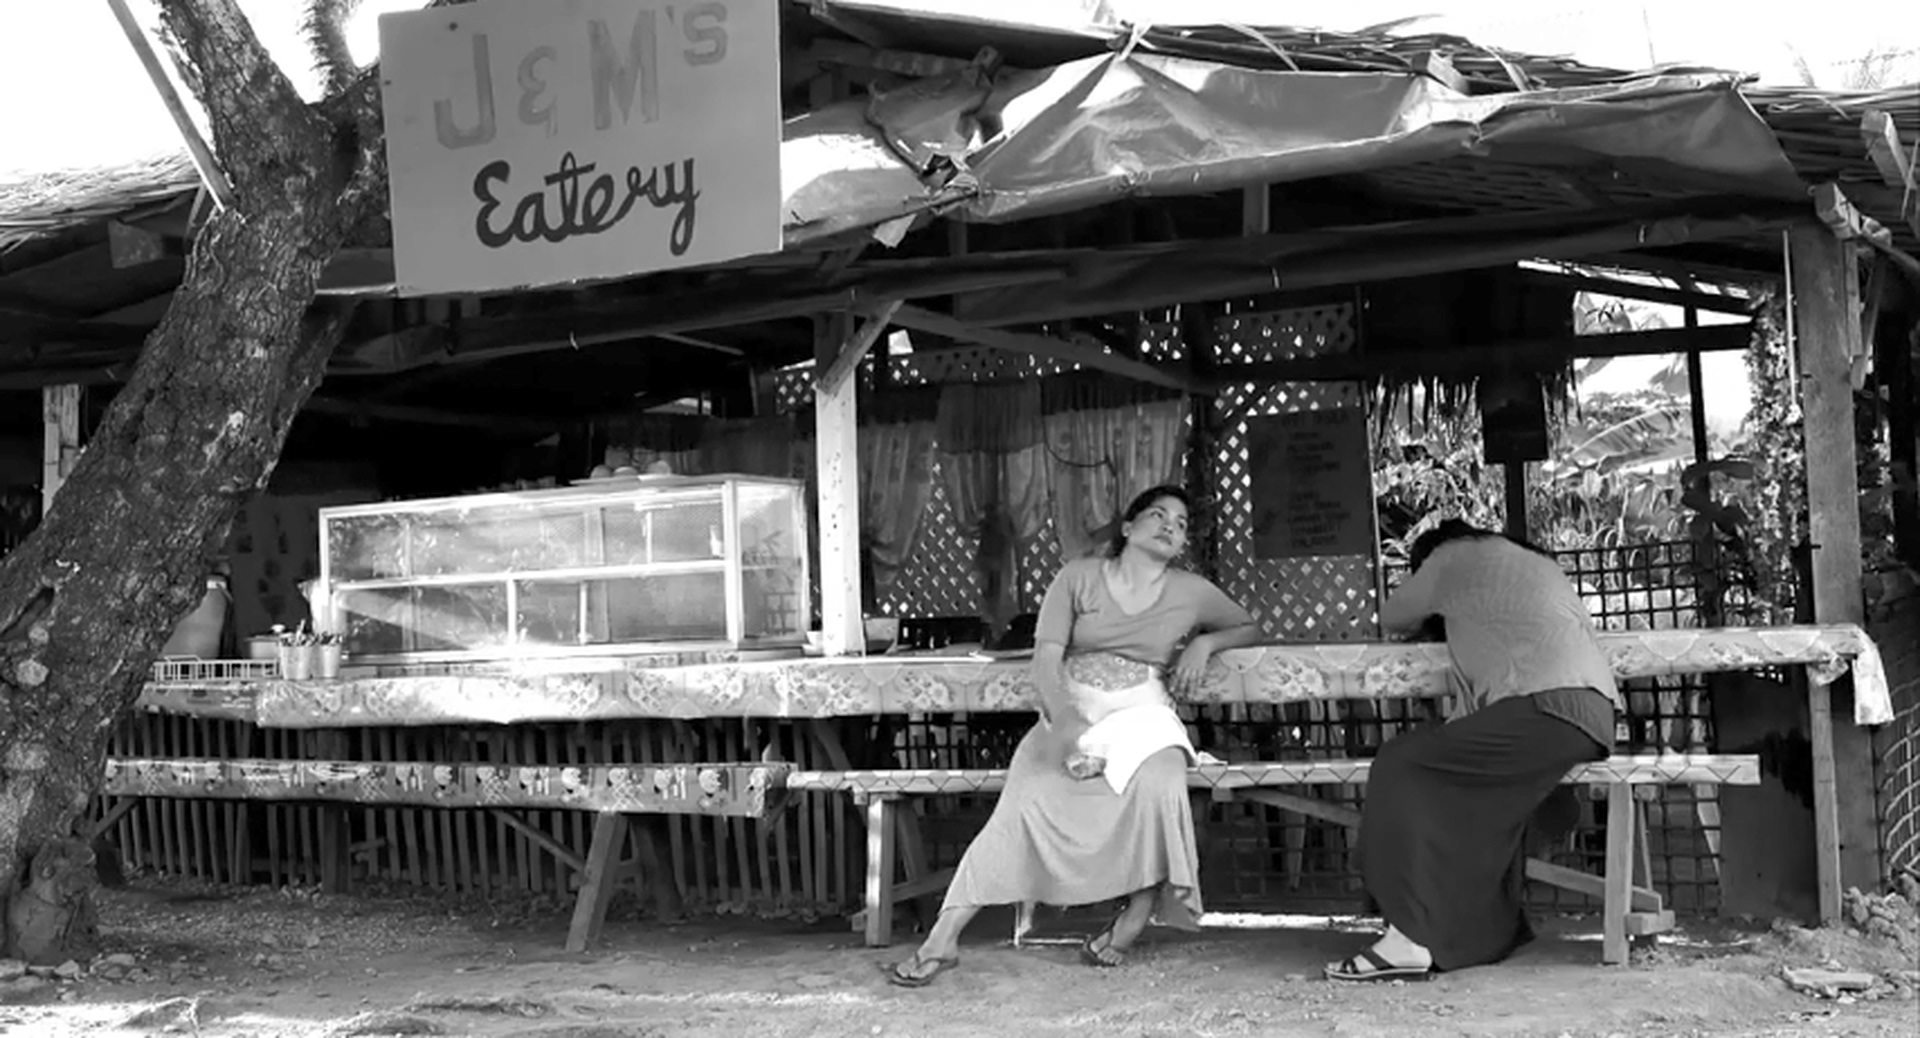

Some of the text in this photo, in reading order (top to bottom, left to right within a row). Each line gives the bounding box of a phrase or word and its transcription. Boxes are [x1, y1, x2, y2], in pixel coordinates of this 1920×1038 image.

[433, 3, 729, 150] J & M's
[473, 151, 701, 257] Eatery
